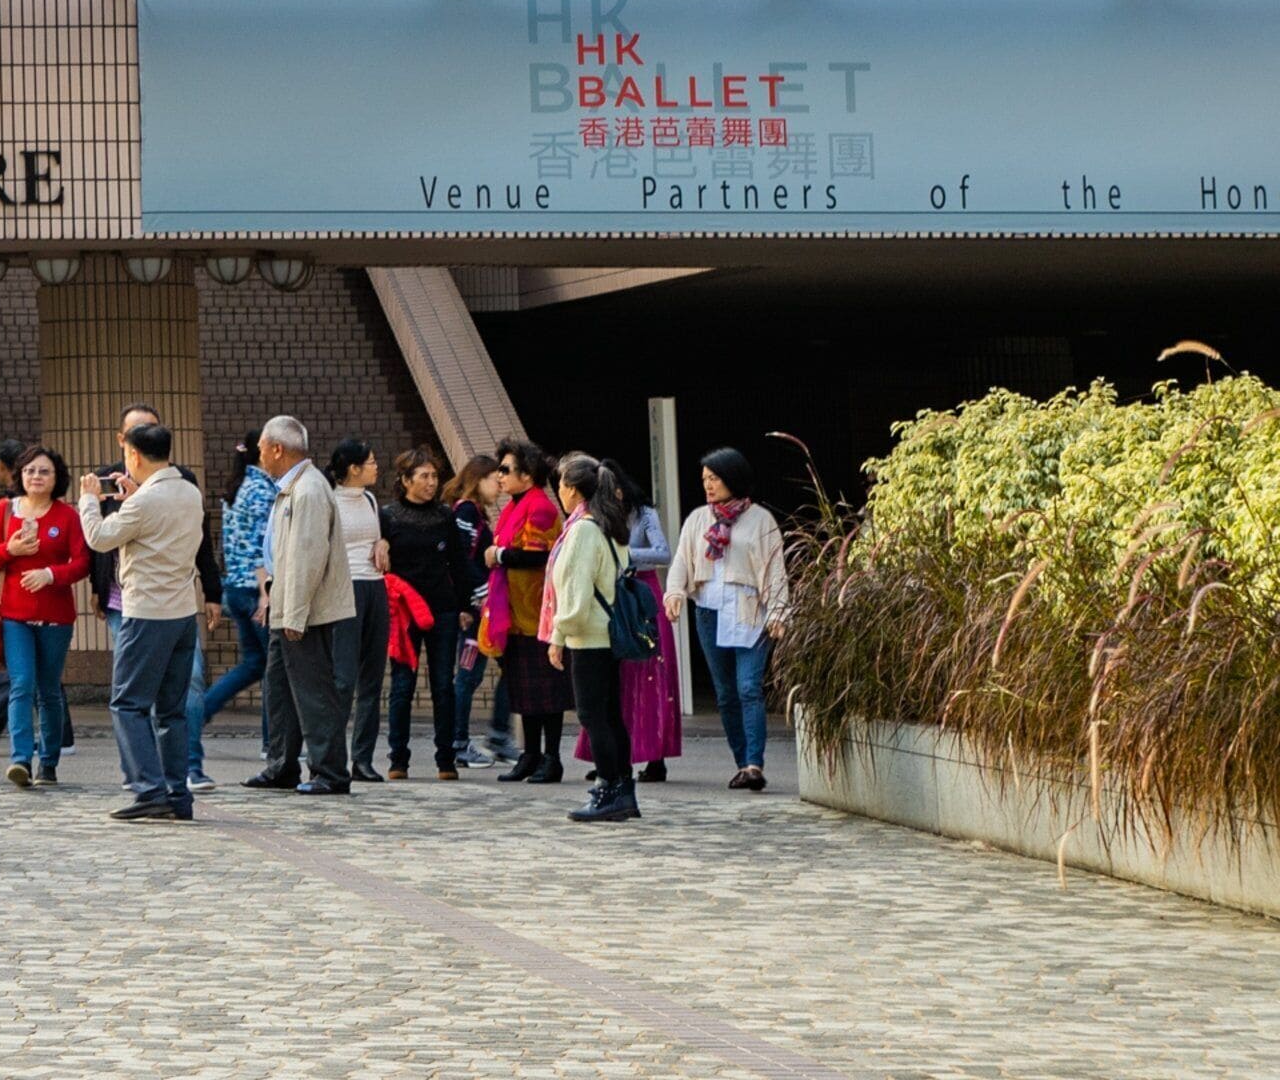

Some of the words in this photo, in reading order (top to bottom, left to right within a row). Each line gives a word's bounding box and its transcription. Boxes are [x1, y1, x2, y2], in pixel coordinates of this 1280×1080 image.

[577, 34, 644, 65] HK
[578, 76, 785, 108] BALLET
[578, 117, 788, 148] 香港芭蕾舞團
[419, 176, 552, 210] Venue
[642, 176, 838, 210] Partners
[929, 173, 971, 210] of
[1061, 174, 1122, 210] the
